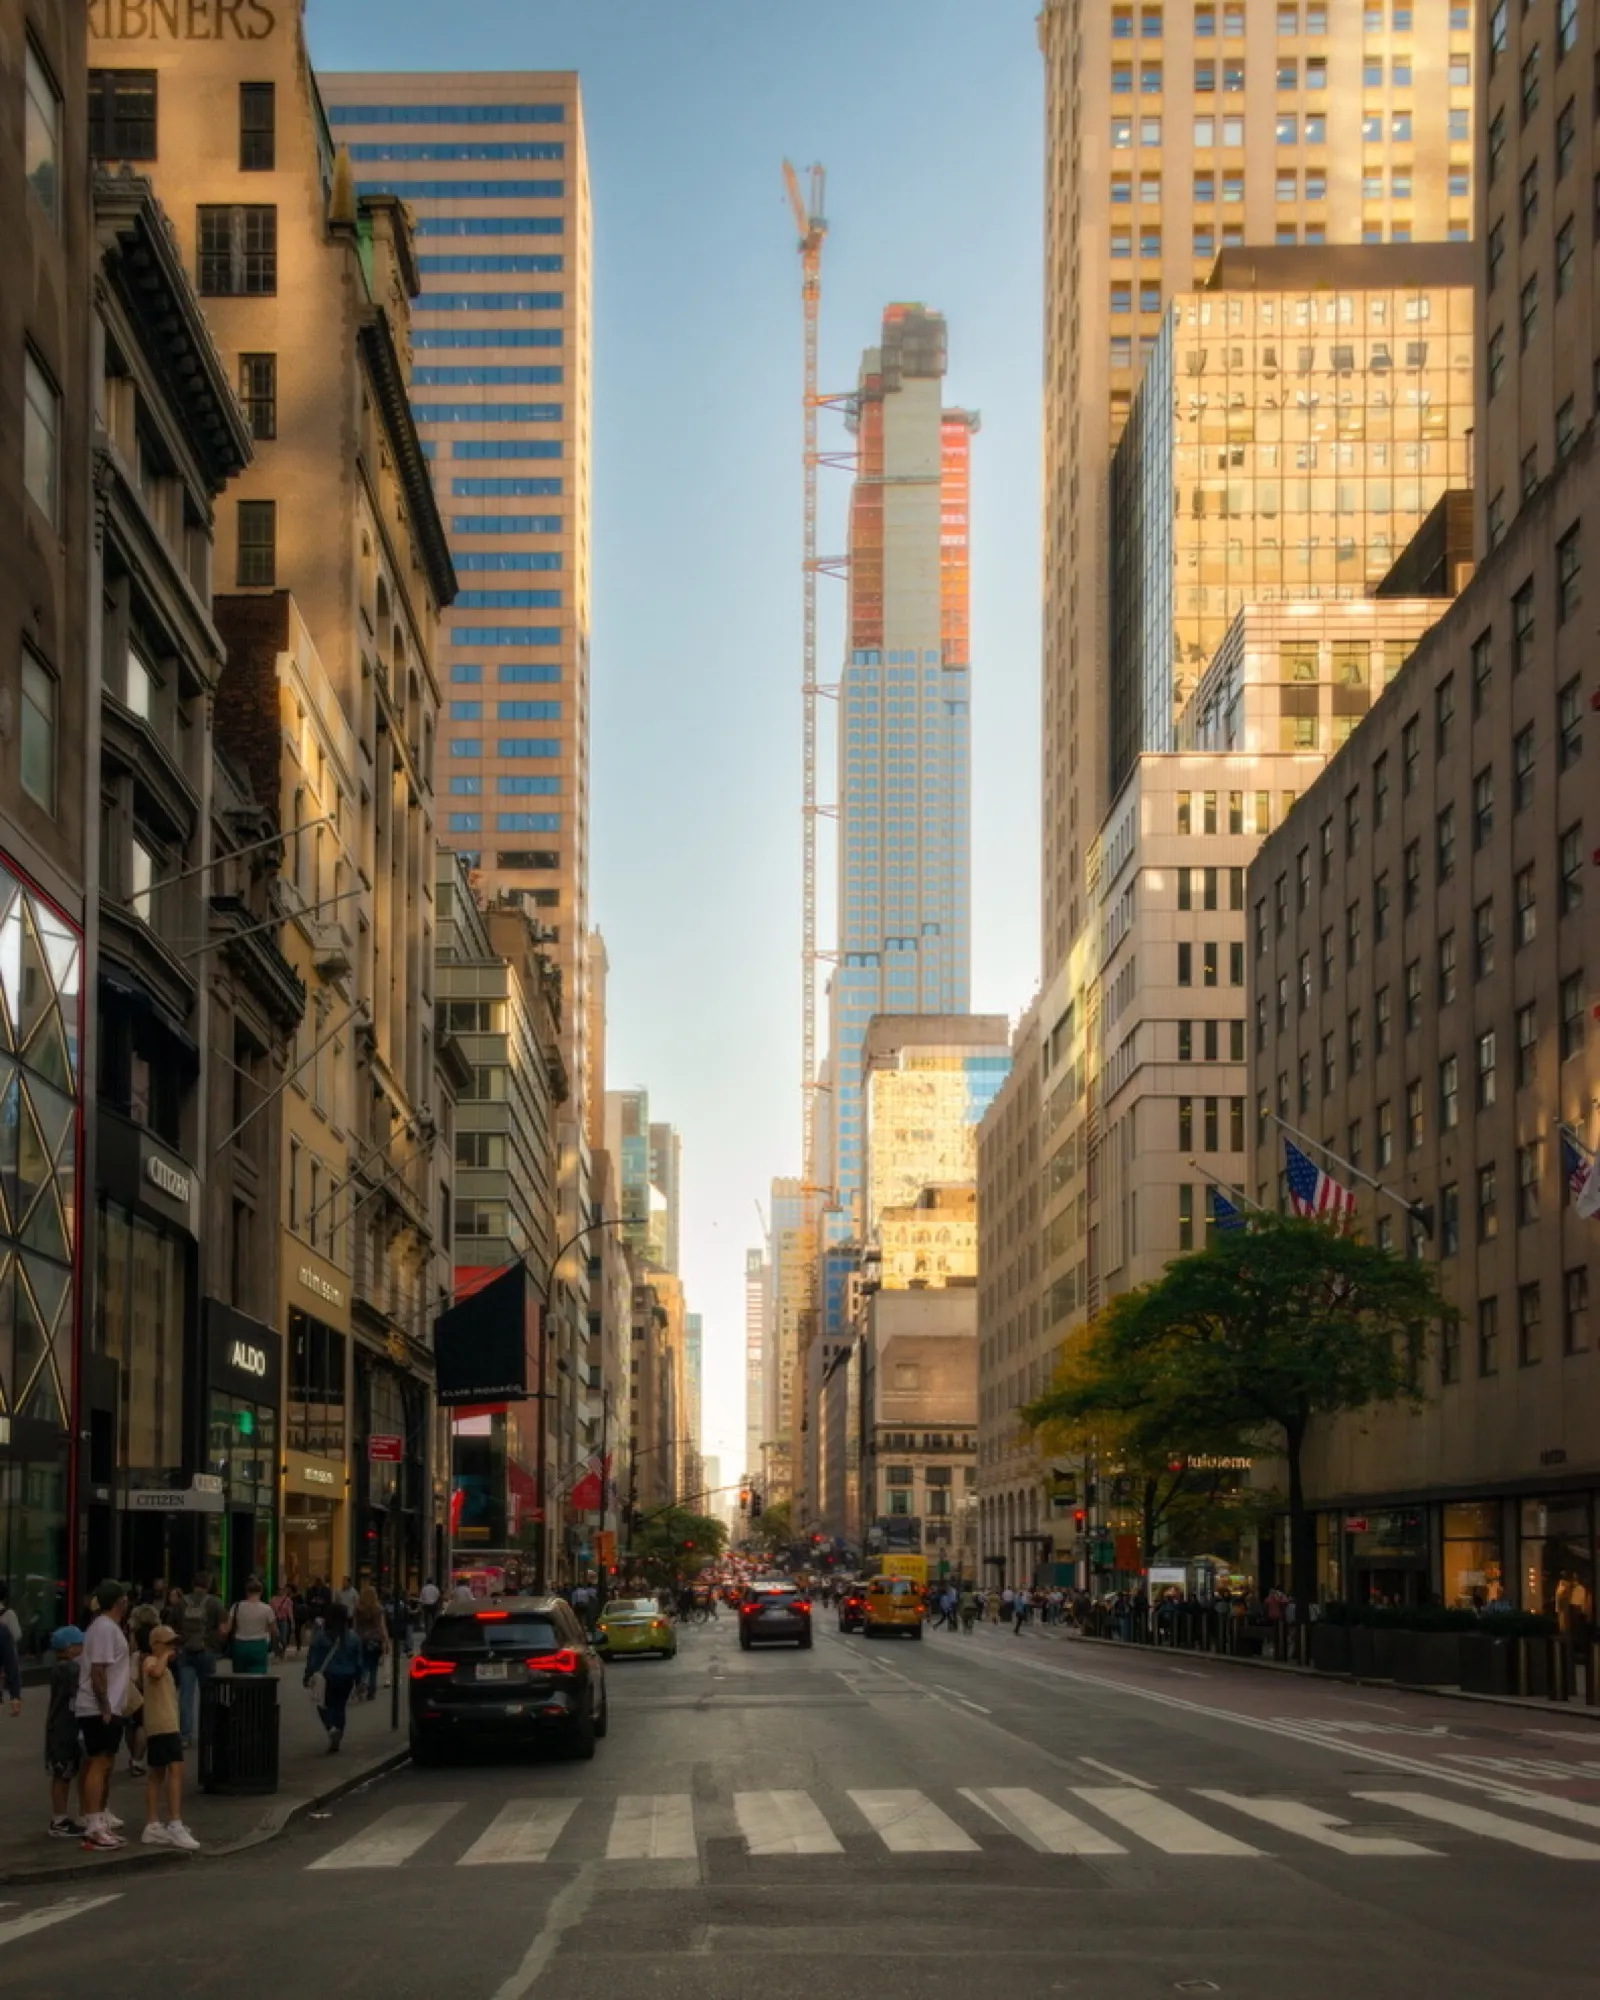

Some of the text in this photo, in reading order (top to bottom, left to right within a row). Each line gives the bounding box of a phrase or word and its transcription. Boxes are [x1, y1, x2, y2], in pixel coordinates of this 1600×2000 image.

[147, 1156, 189, 1203] CITIZEN
[231, 1340, 266, 1377] ALDO
[136, 1494, 185, 1506] CITIZEN
